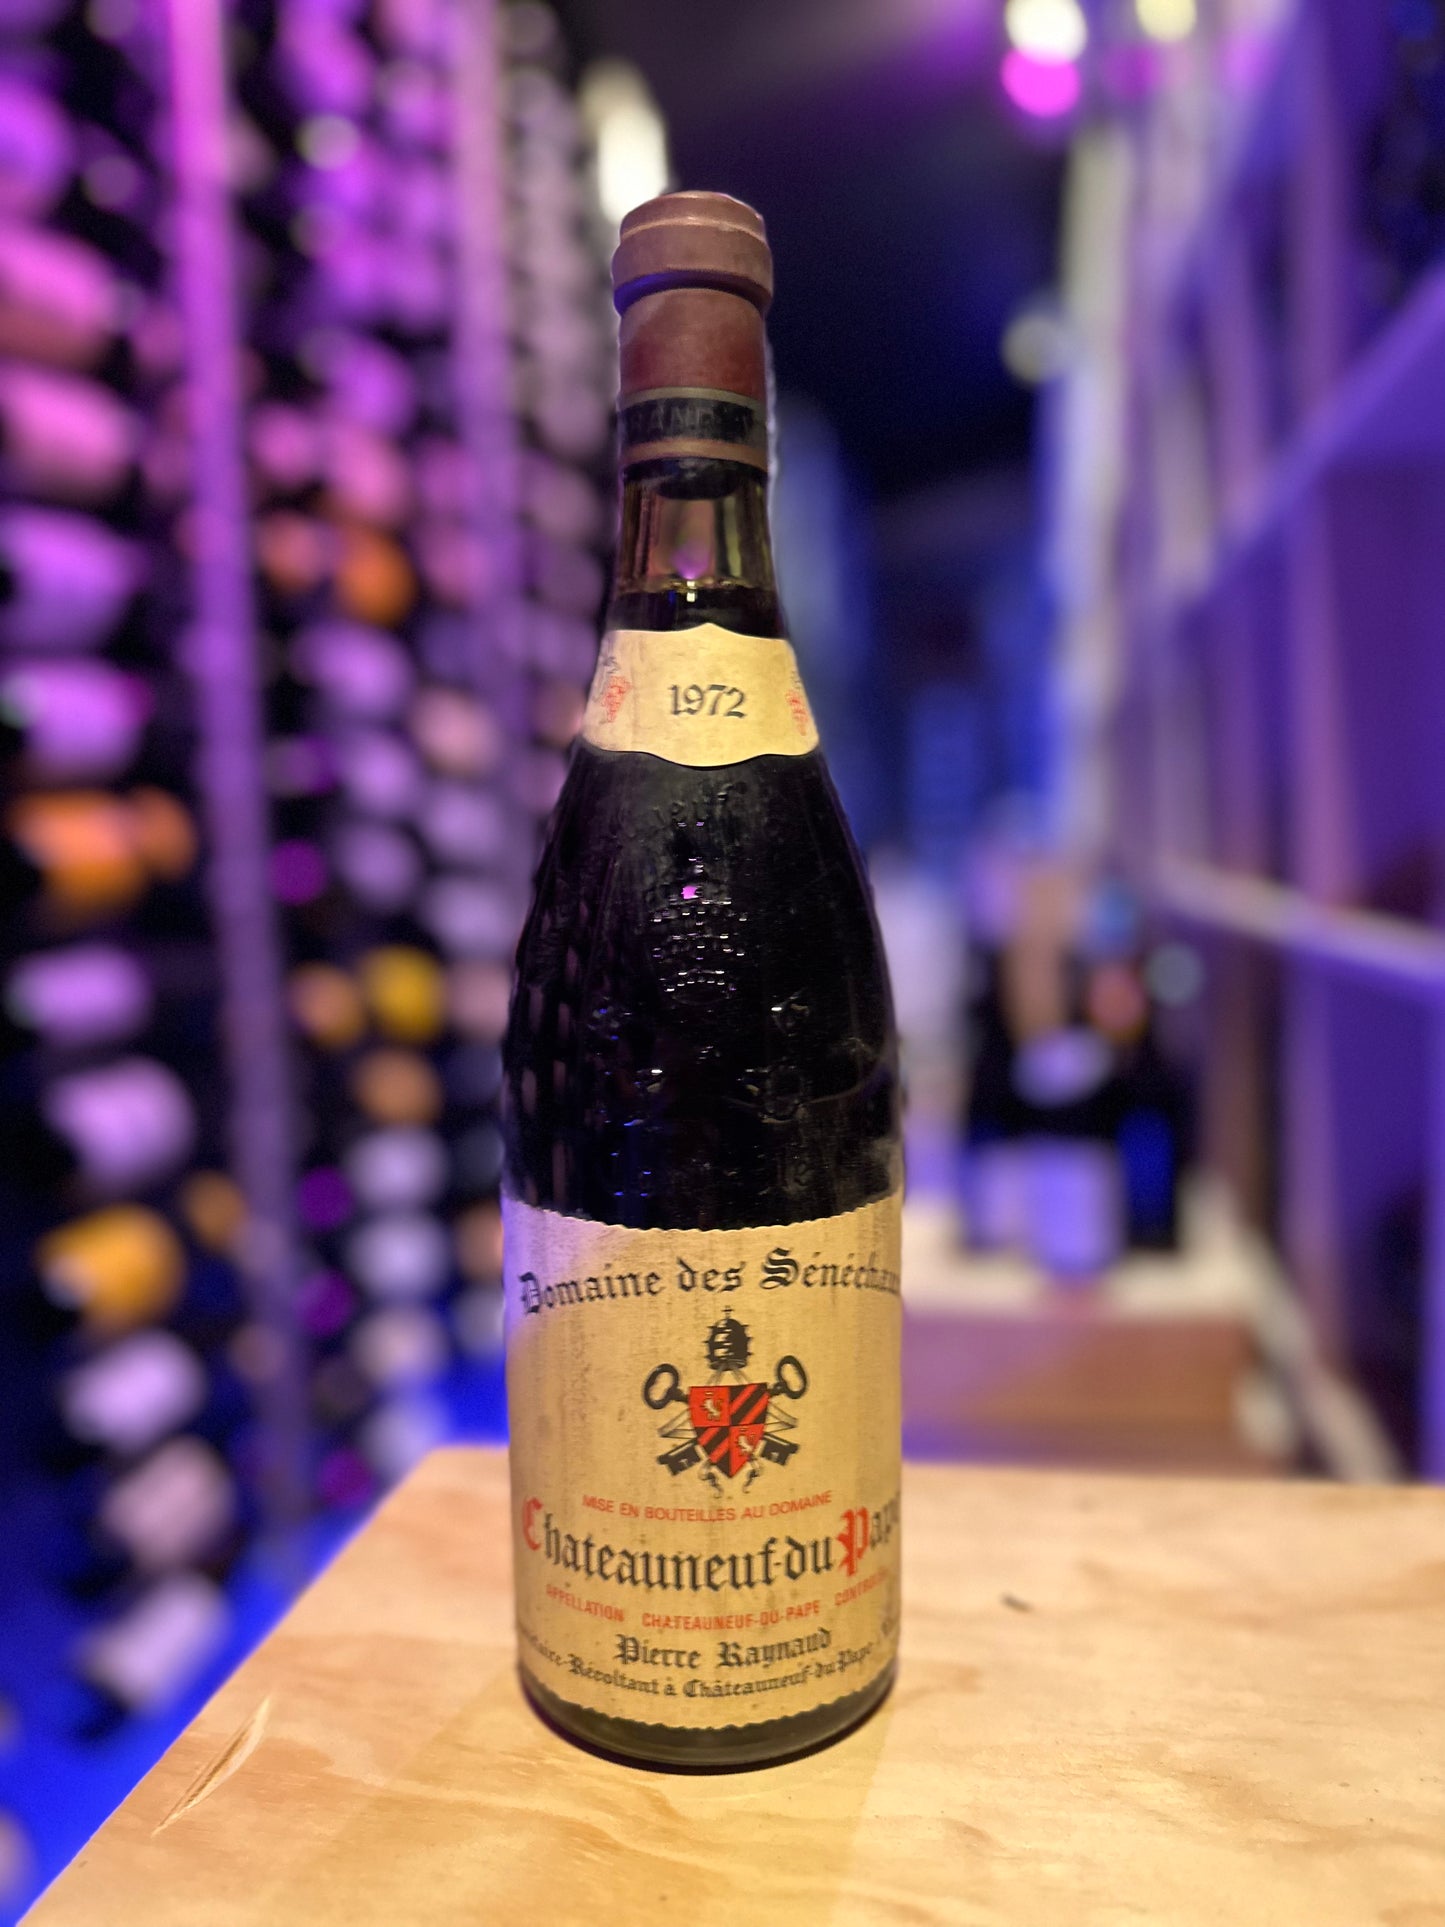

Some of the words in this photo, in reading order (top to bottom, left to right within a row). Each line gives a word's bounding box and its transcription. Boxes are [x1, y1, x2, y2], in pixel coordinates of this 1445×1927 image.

[668, 684, 747, 719] 1972
[518, 1262, 666, 1314] Domaine
[676, 1257, 746, 1293] des
[759, 1247, 899, 1297] Sénéchau
[581, 1494, 614, 1513] MISE
[619, 1502, 639, 1518] EN
[644, 1506, 736, 1523] BOUTEILLES
[741, 1506, 764, 1520] AU
[768, 1489, 832, 1517] DOMAINE
[545, 1583, 625, 1623] APPELLATION
[614, 1633, 701, 1669] Pierre
[716, 1626, 832, 1669] Raynaud
